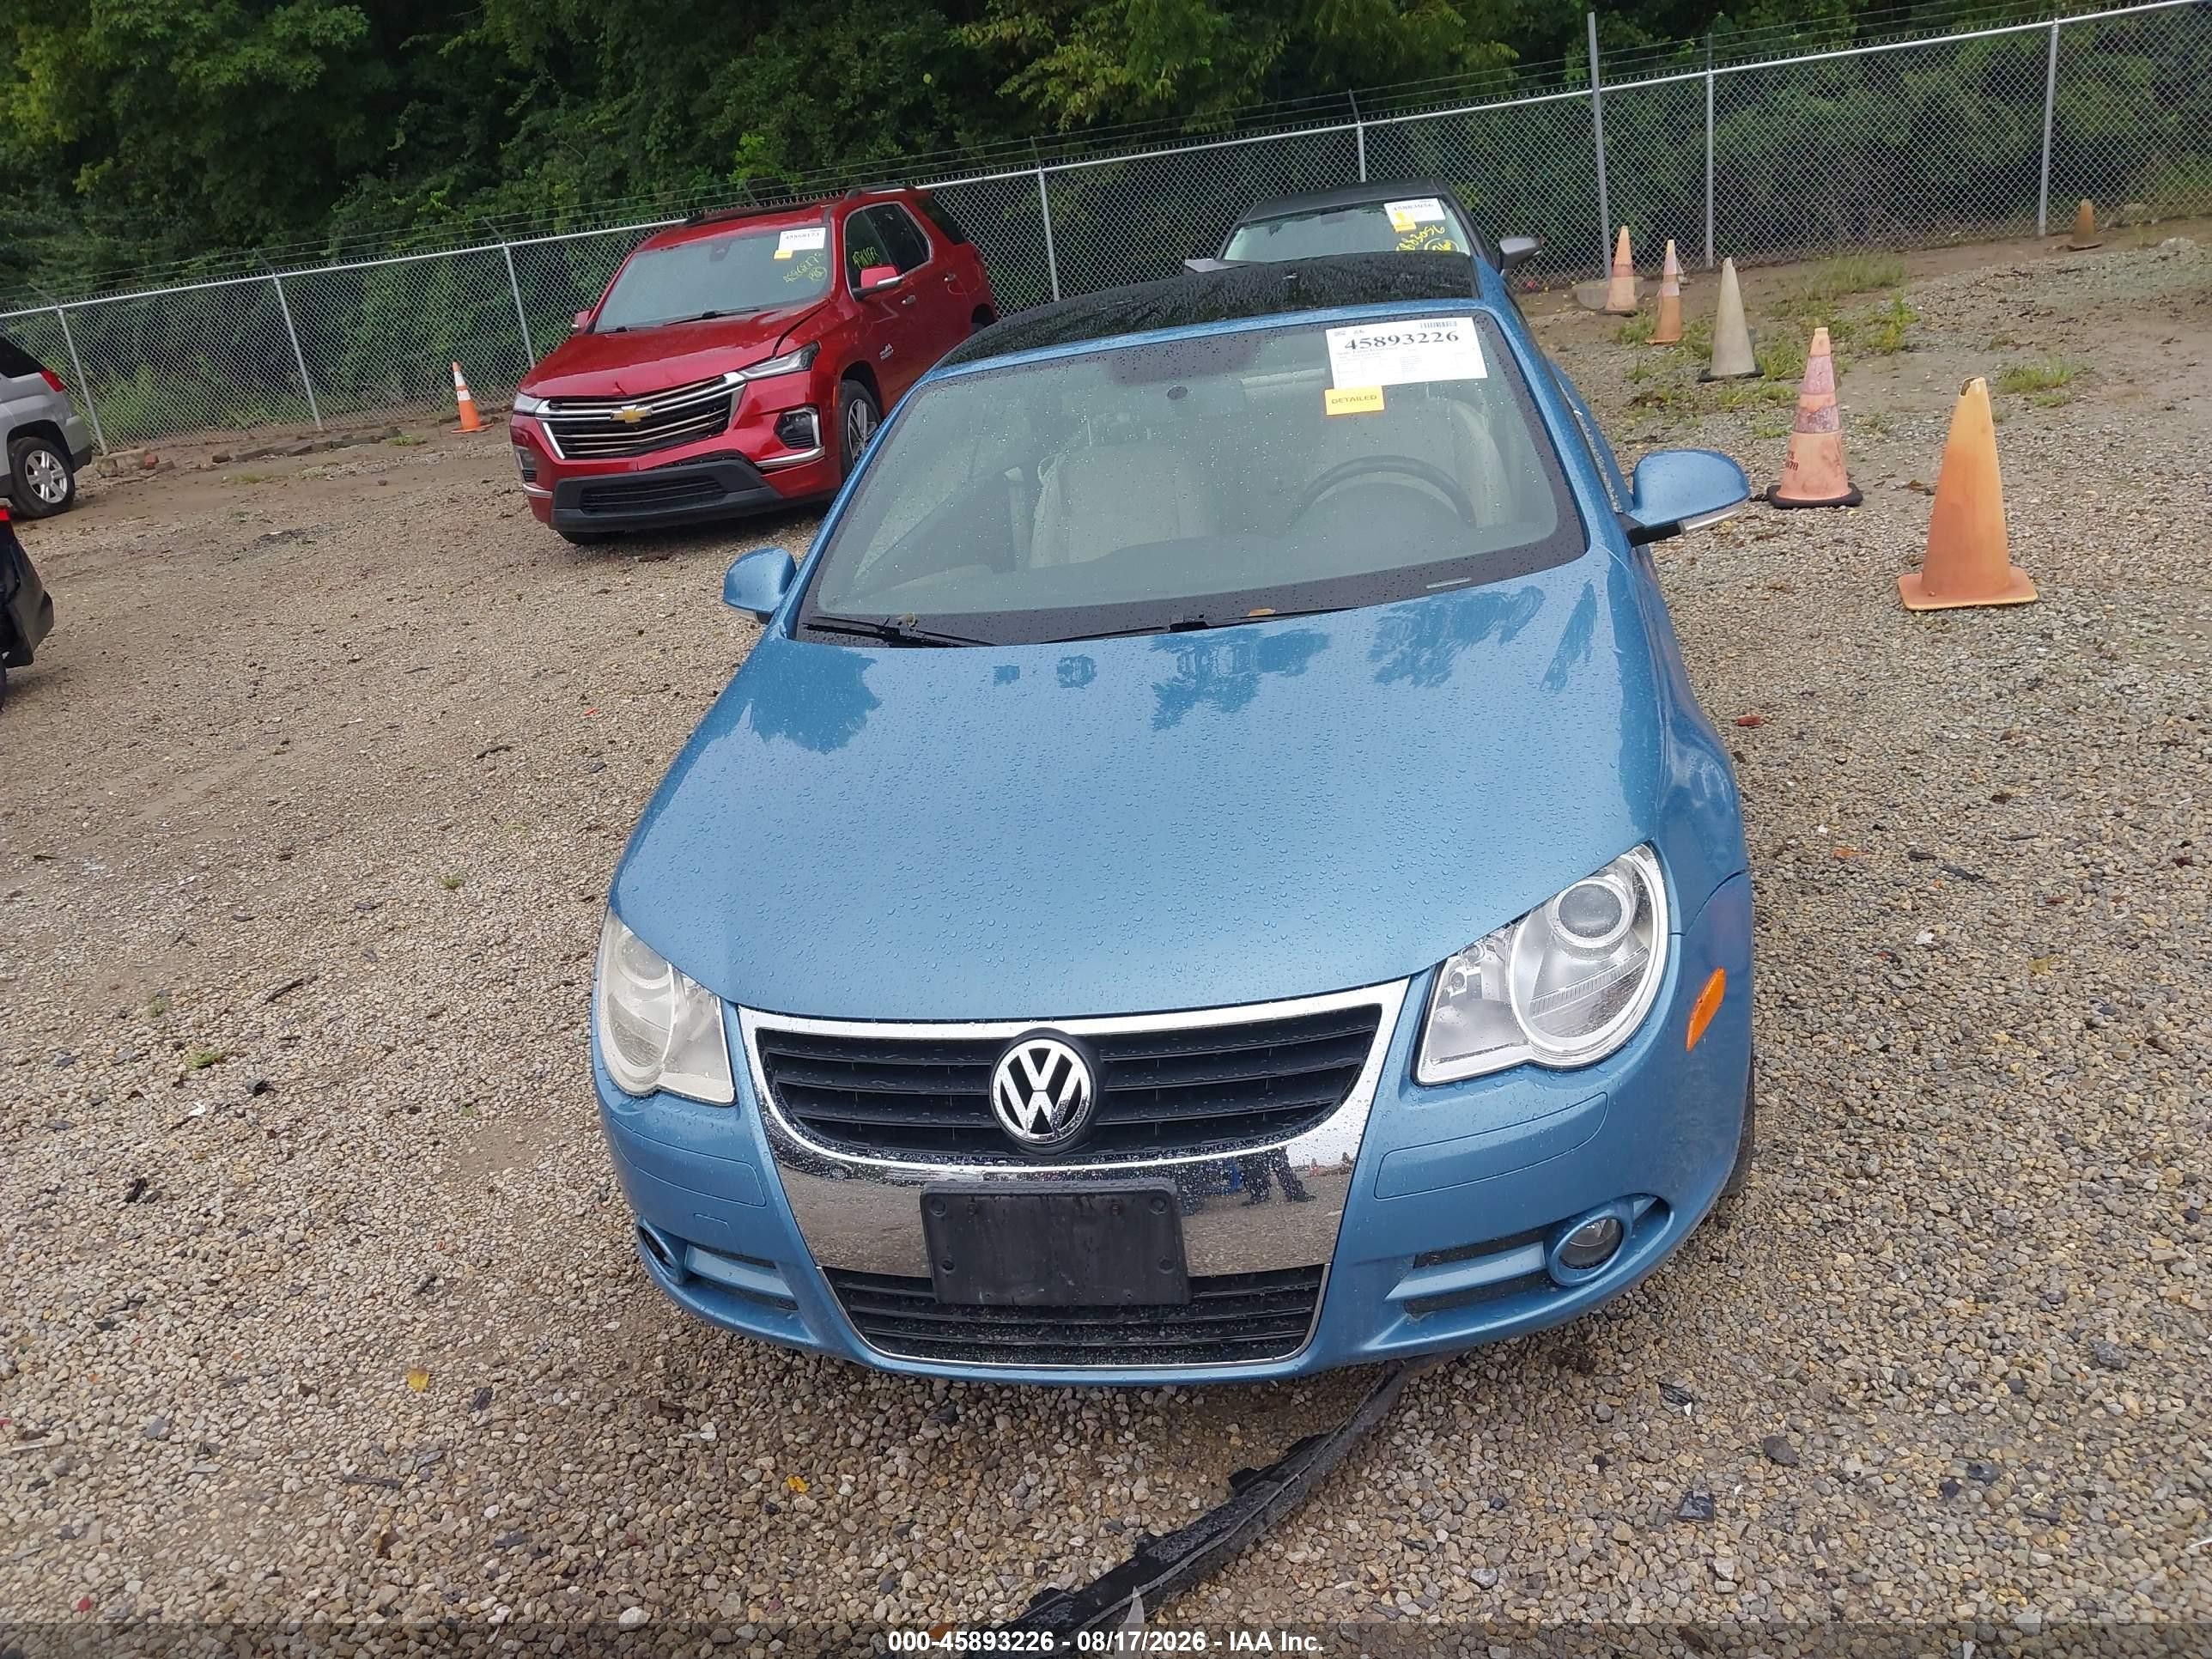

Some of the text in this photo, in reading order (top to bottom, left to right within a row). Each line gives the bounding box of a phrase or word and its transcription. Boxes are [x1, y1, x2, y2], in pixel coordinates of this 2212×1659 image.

[1344, 330, 1460, 350] 45893226
[1331, 394, 1377, 404] DETAILED
[994, 1039, 1091, 1144] VW
